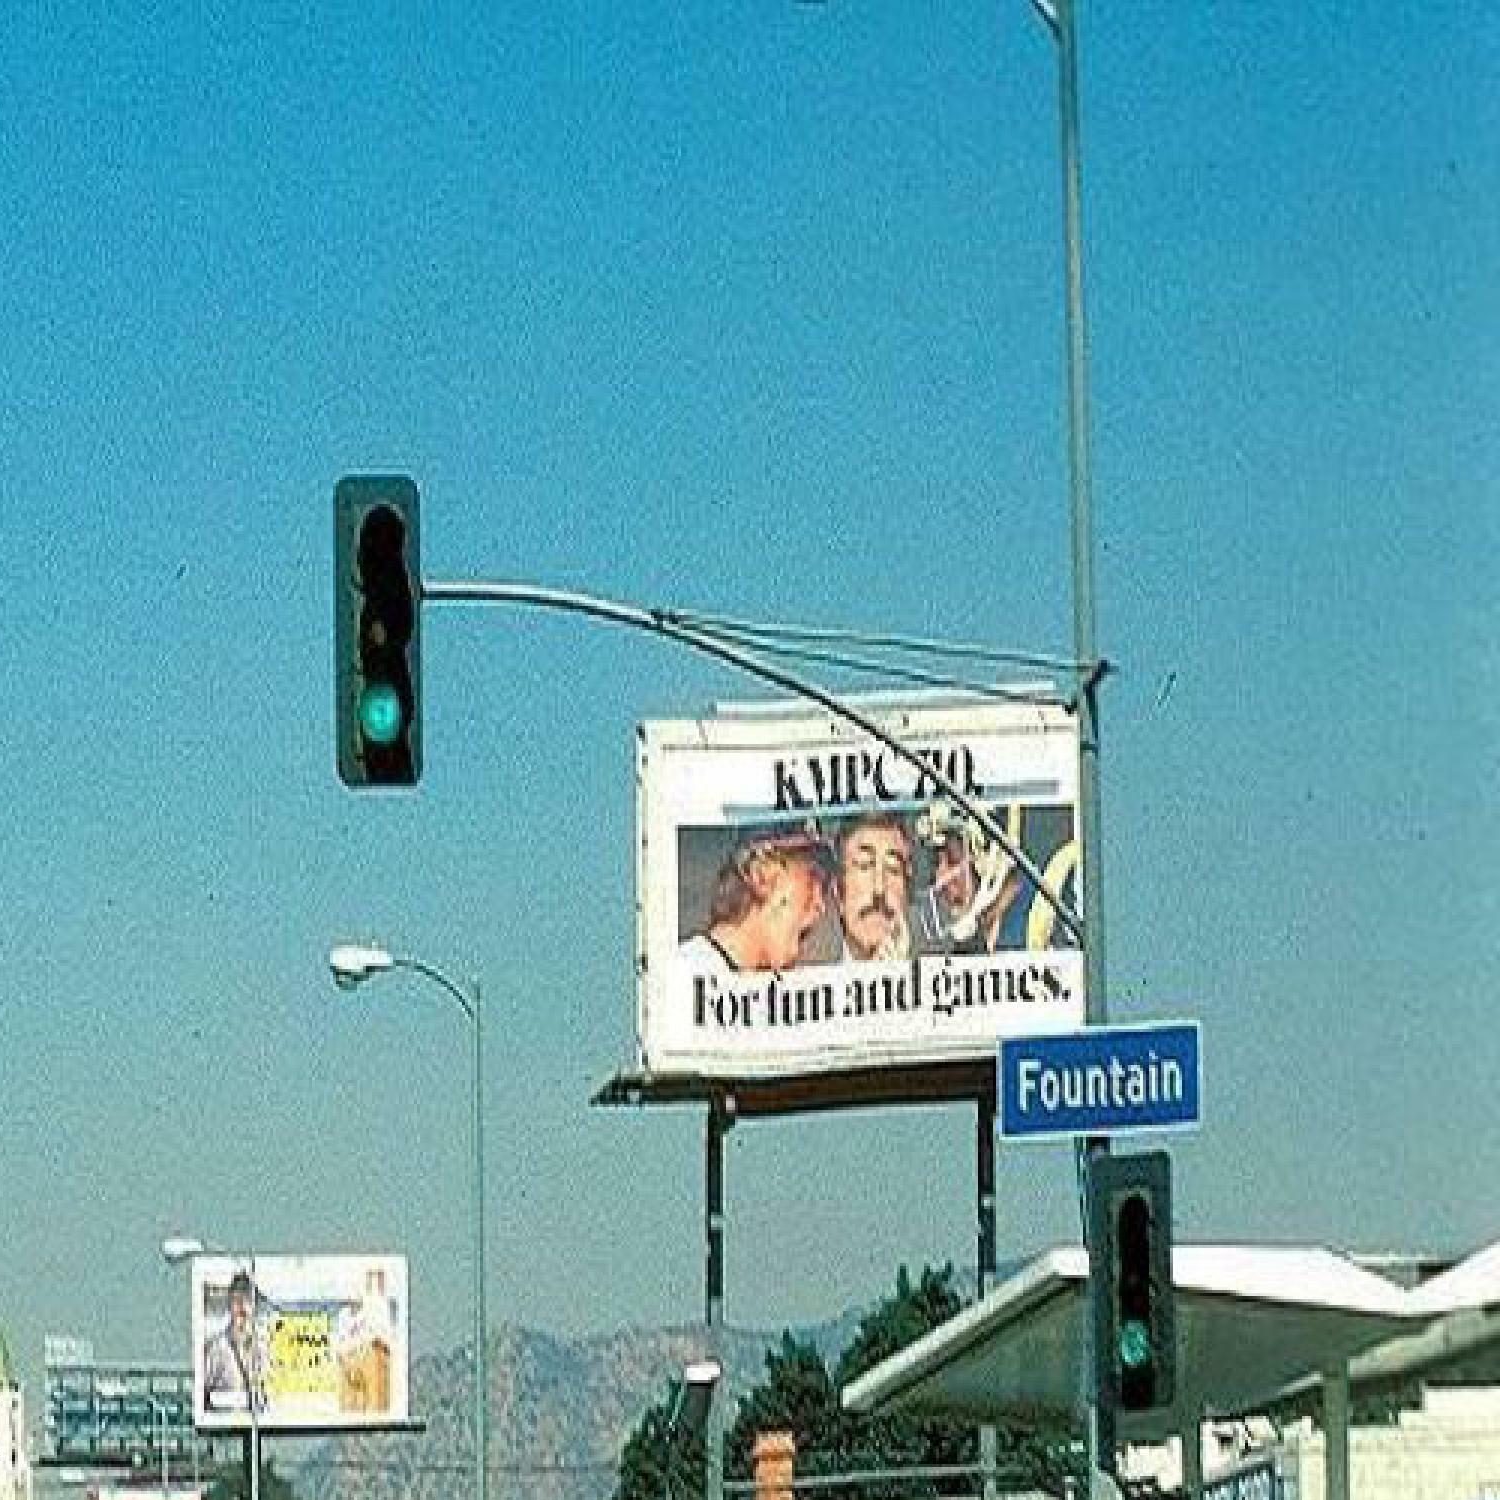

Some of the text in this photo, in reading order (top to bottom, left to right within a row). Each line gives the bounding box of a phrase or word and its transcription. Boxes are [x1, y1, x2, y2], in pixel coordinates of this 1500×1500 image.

[774, 749, 896, 810] KMPC
[693, 957, 1071, 1028] For fun and games.
[1018, 1050, 1183, 1113] Fountain
